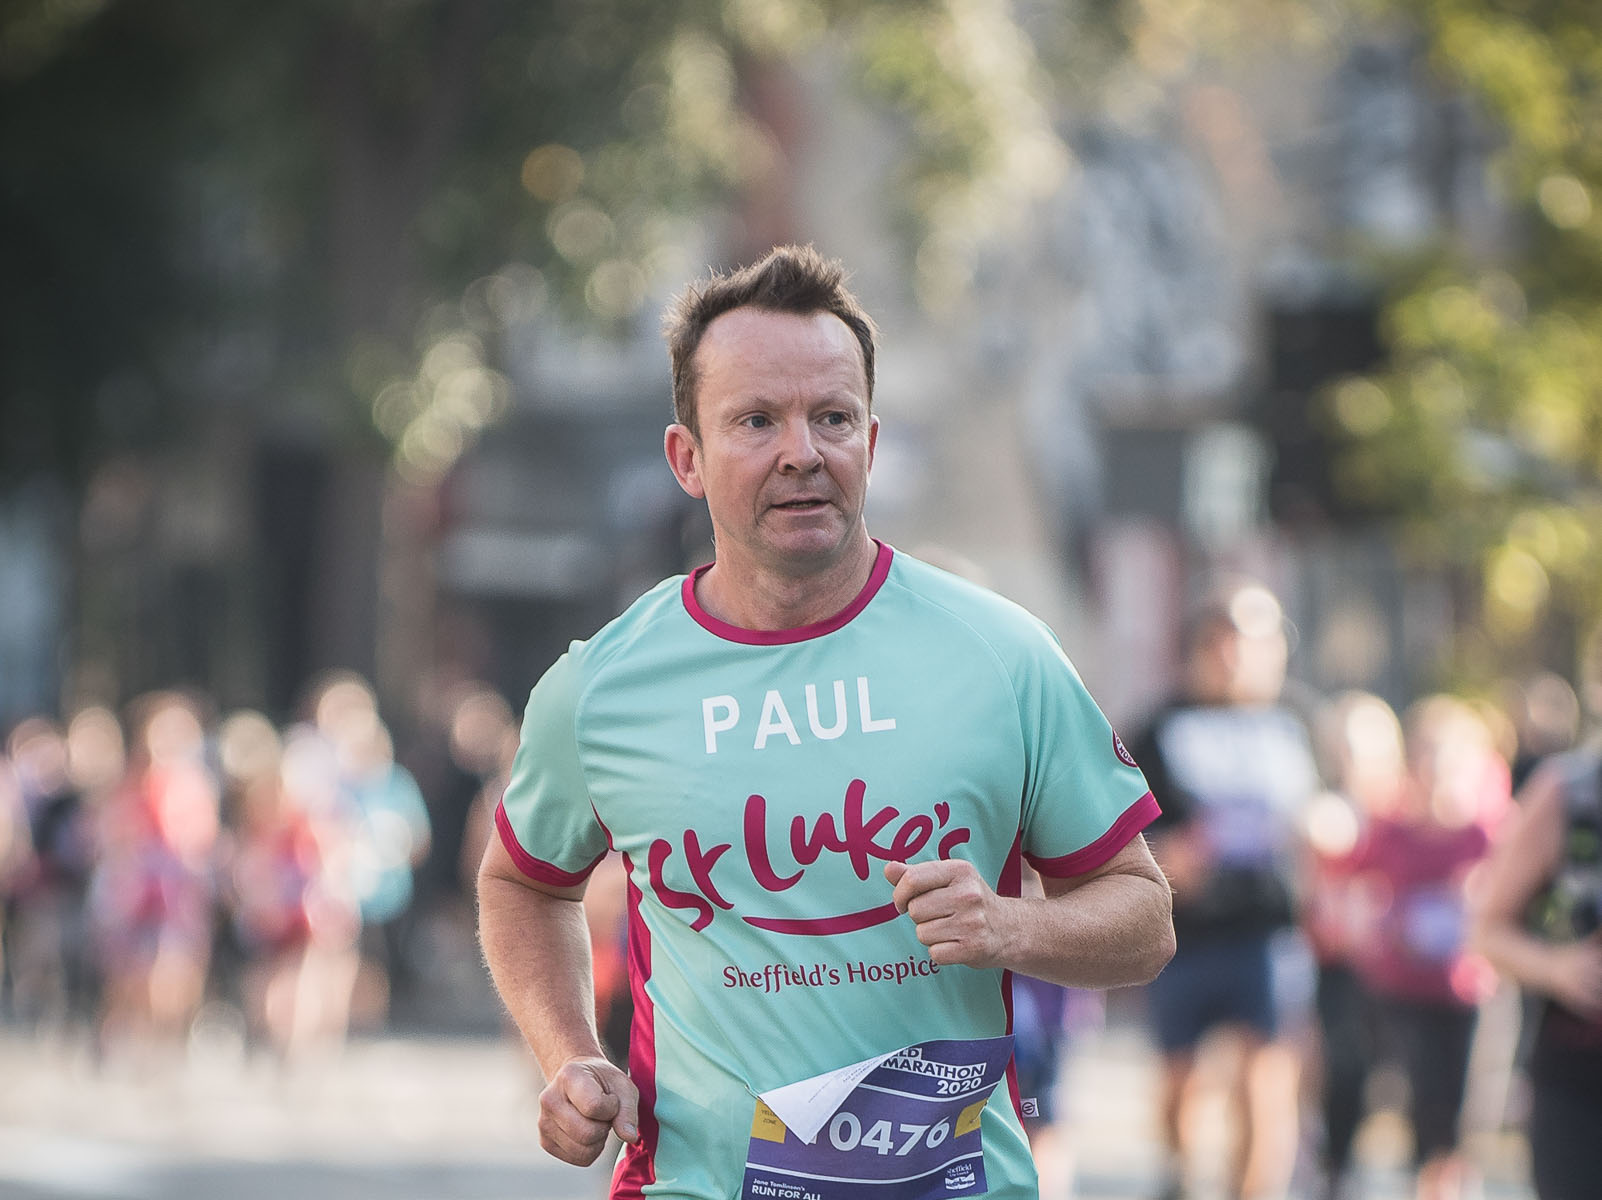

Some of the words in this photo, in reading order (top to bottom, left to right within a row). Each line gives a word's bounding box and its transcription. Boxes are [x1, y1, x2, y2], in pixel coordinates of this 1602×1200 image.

[702, 677, 896, 754] PAUL
[722, 963, 840, 993] Sheffield's
[847, 955, 940, 984] Hospice
[883, 1058, 984, 1079] MARATHON
[936, 1078, 982, 1095] 2020
[751, 1185, 777, 1197] RUN
[778, 1189, 801, 1199] FOR
